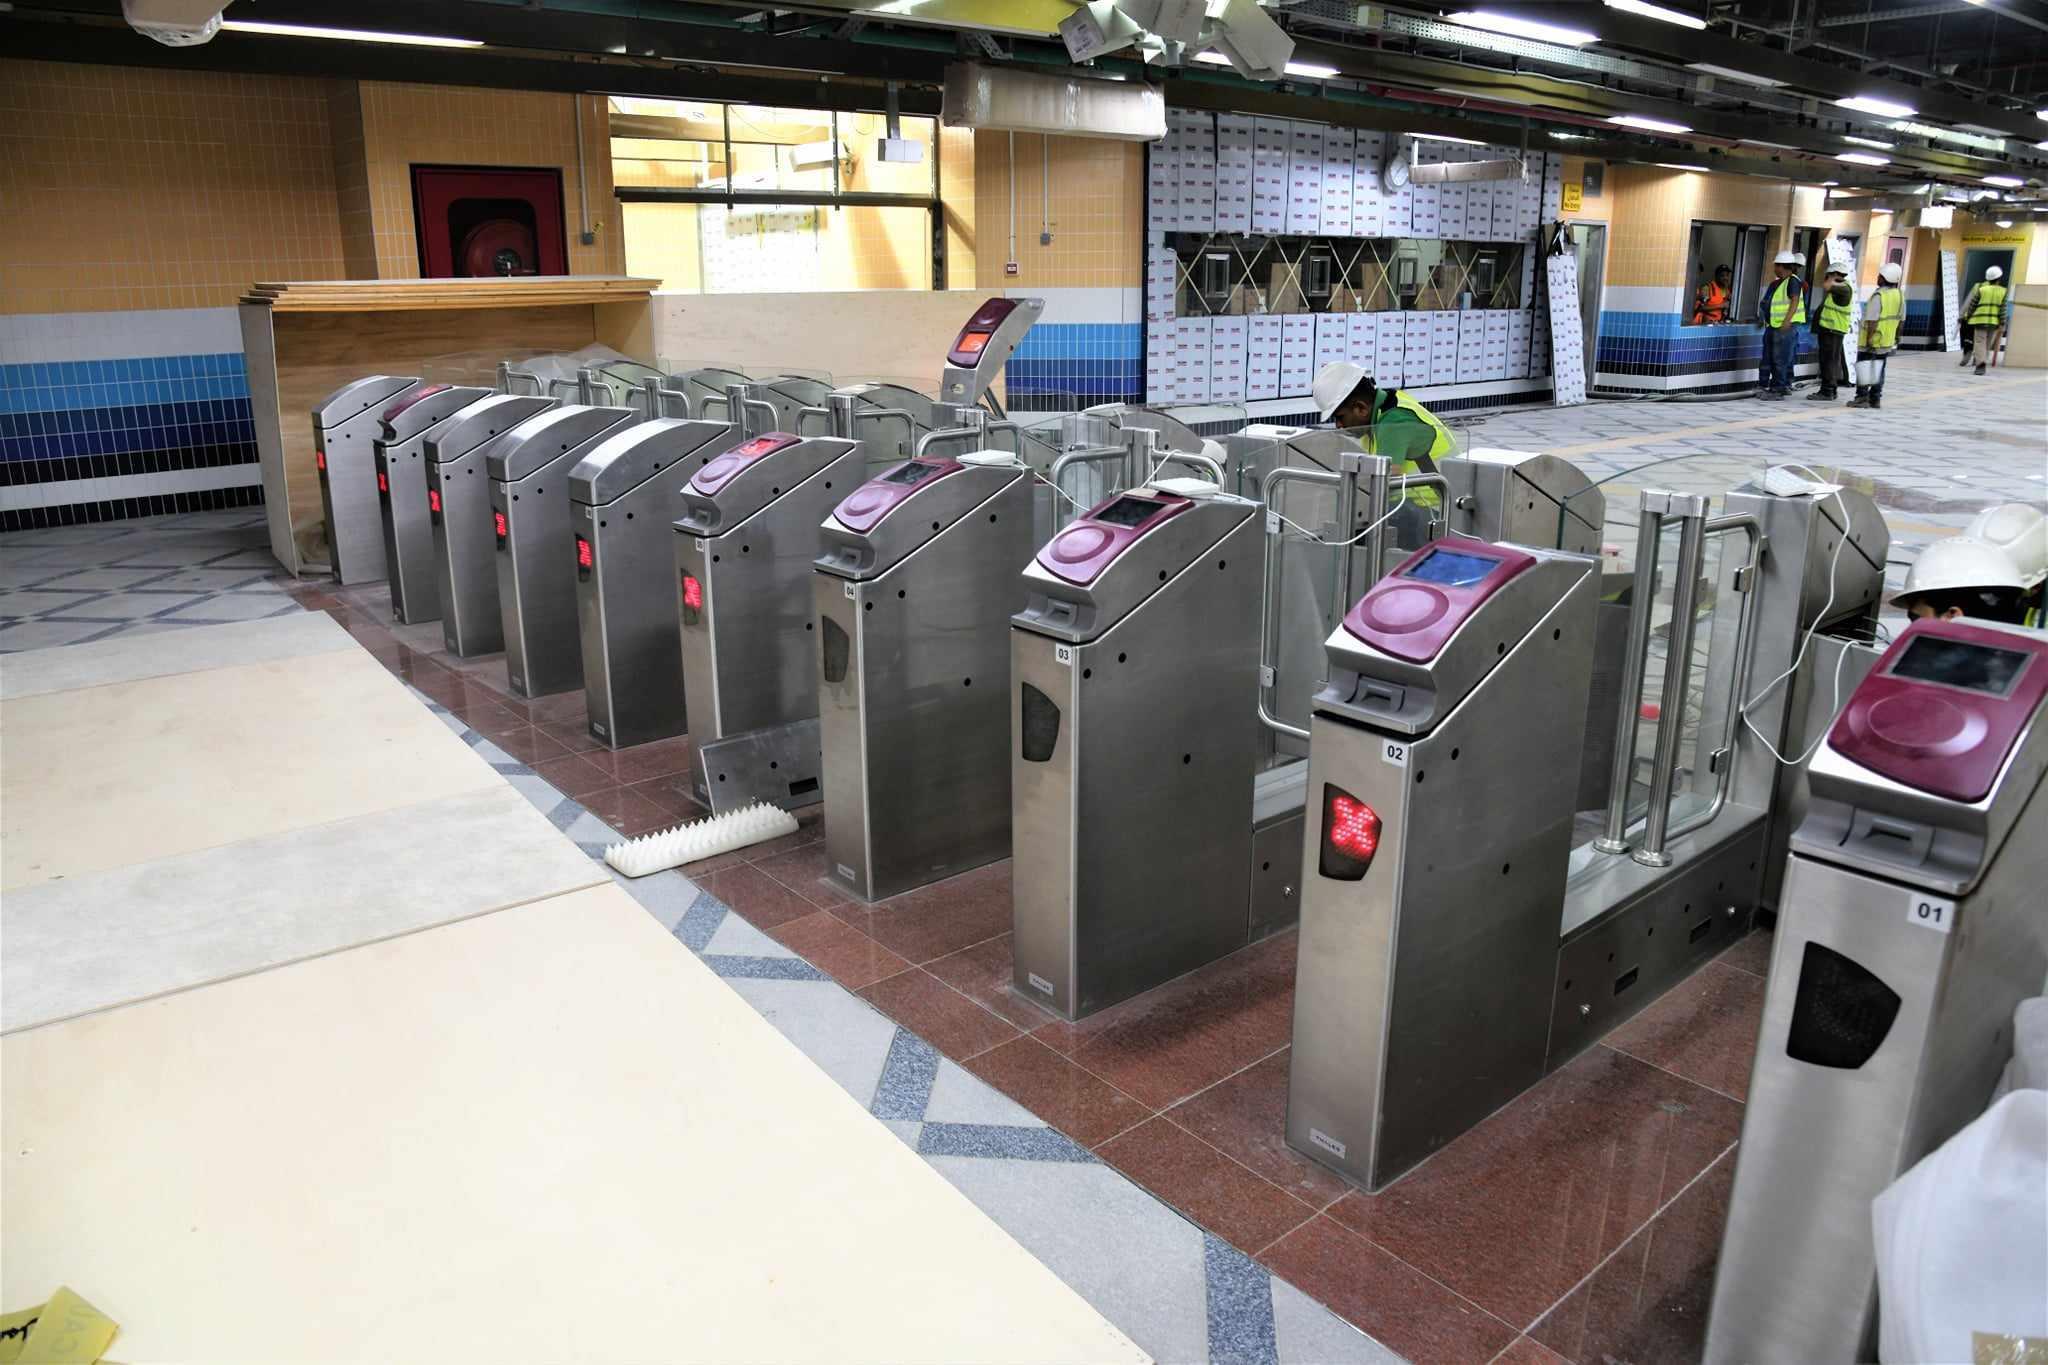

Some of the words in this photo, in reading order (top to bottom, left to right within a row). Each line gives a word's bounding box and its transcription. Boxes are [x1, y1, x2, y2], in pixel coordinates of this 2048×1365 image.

[846, 586, 854, 596] 04
[1058, 648, 1069, 660] 03
[1387, 744, 1403, 761] 02
[1918, 902, 1942, 923] 01
